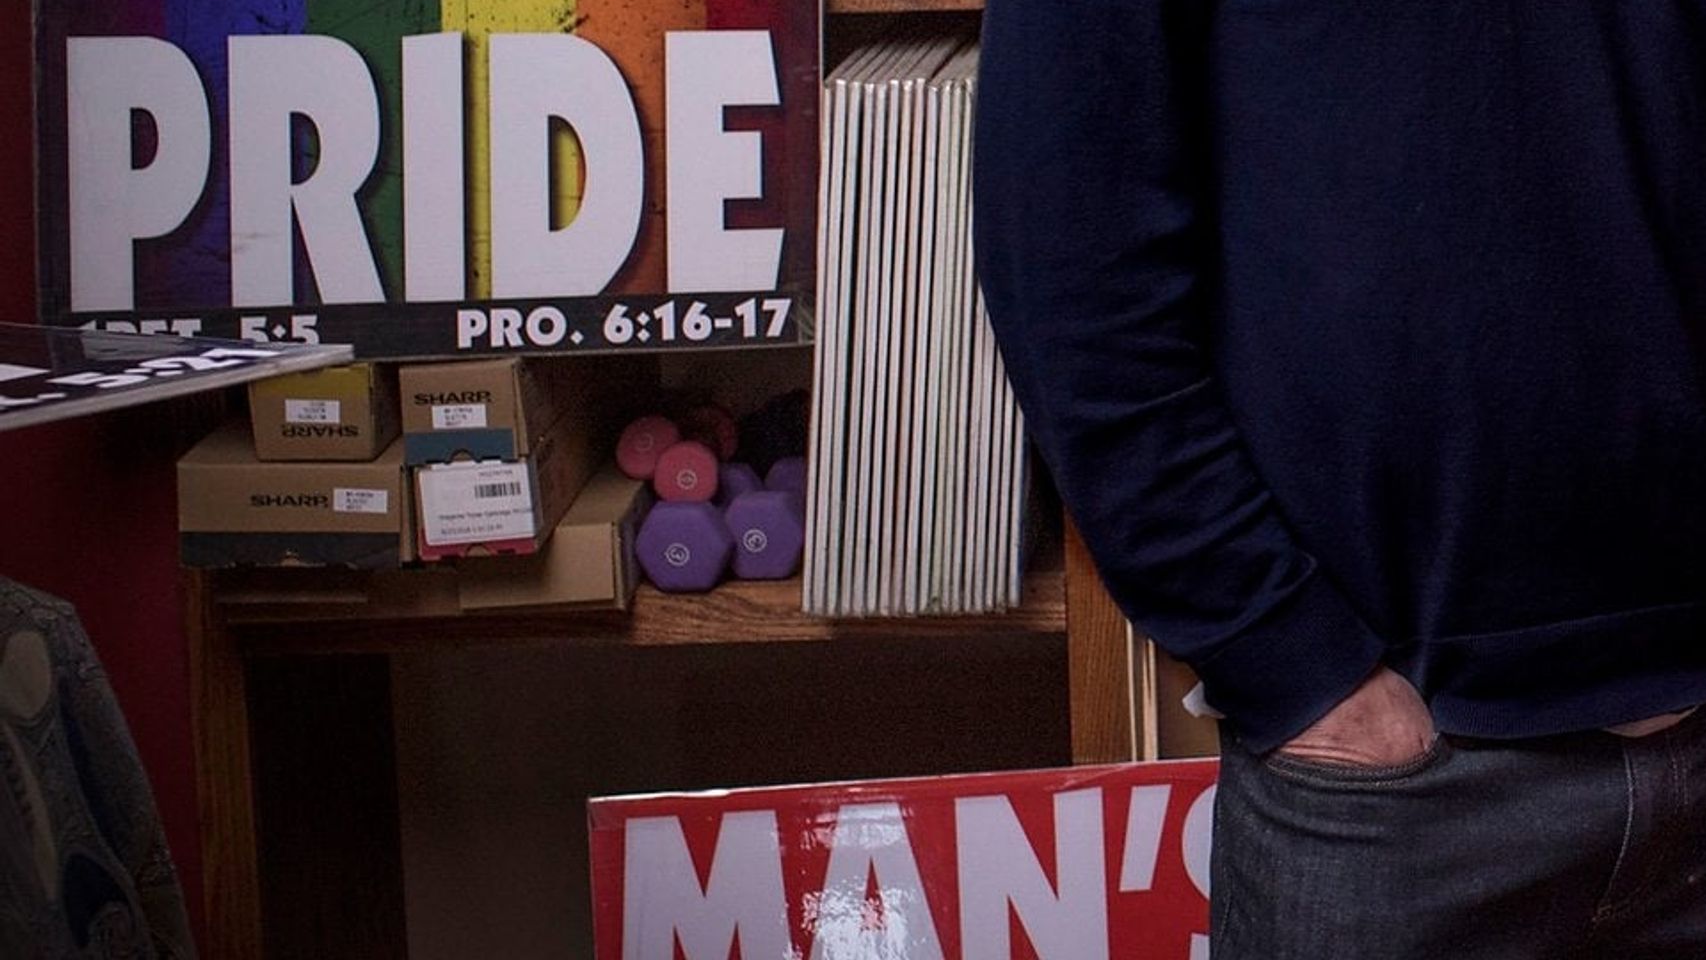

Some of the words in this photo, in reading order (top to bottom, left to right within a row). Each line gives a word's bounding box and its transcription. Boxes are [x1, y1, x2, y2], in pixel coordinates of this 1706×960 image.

[66, 30, 784, 311] PRIDE
[457, 306, 584, 349] PRO.
[603, 298, 791, 343] 6:16-17
[414, 392, 491, 407] SHARP
[281, 424, 359, 438] SHARP
[251, 495, 329, 508] SHARP
